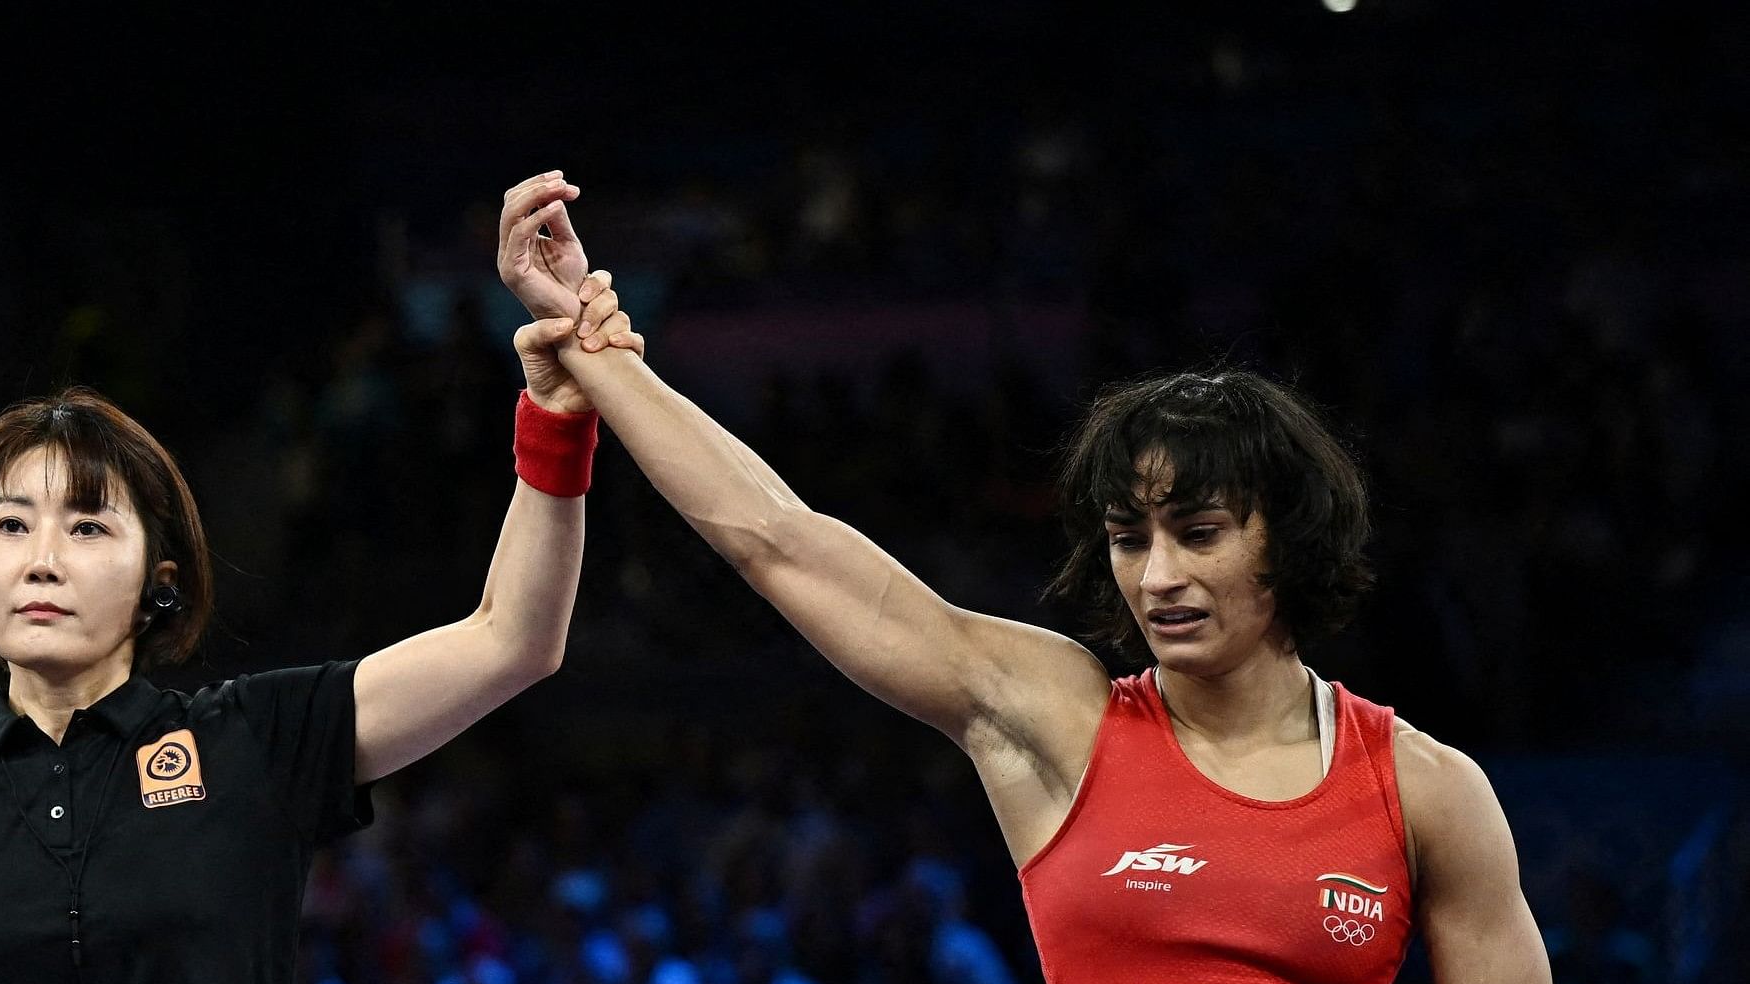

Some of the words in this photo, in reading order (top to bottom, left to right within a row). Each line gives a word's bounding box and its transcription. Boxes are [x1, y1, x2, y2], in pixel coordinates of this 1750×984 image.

[148, 786, 201, 804] REFEREE
[1100, 849, 1209, 876] JSW
[1125, 879, 1172, 892] Inspire
[1320, 888, 1383, 922] INDIA
